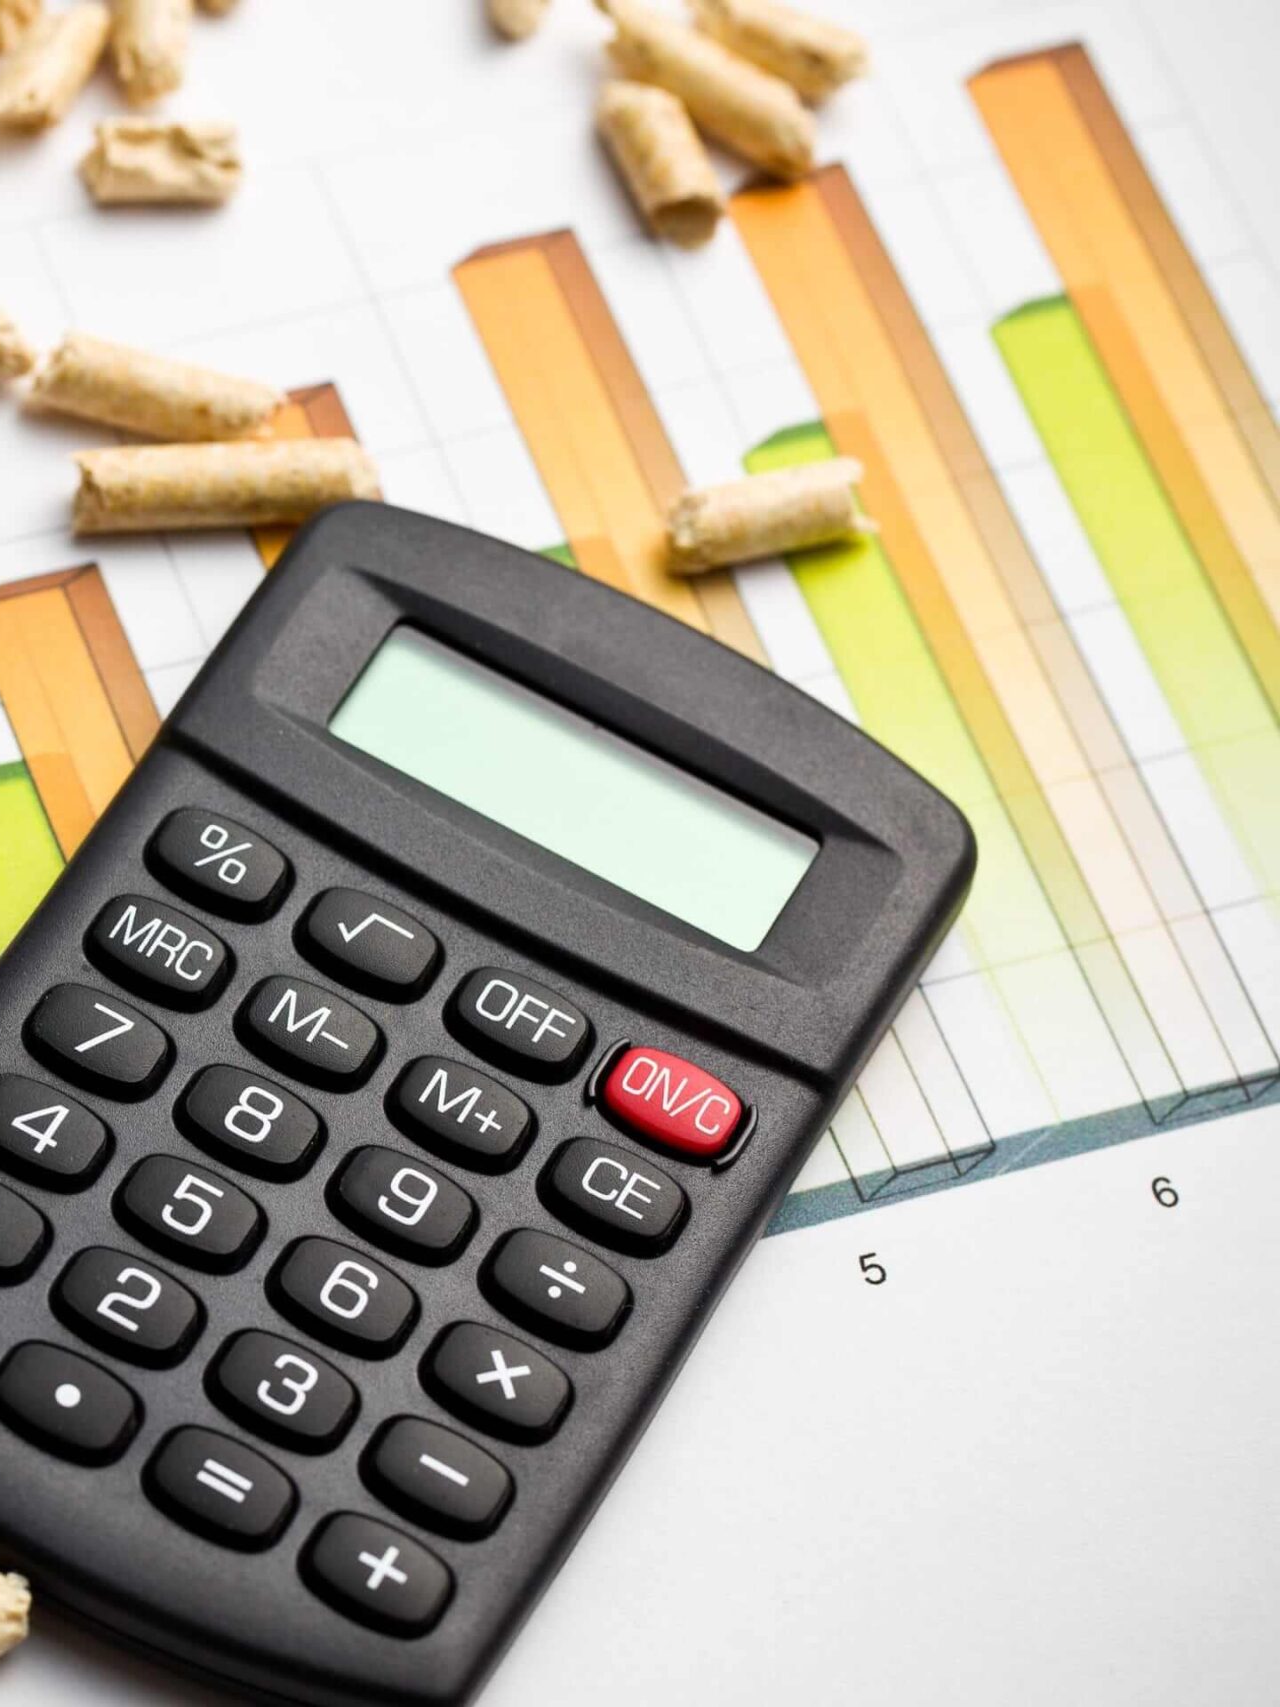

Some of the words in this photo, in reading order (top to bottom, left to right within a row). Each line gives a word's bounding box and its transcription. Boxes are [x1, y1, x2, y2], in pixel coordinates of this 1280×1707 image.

[194, 824, 253, 885] %
[109, 904, 214, 981] MRC
[74, 1002, 135, 1053] 7
[475, 979, 577, 1043] OFF
[224, 1085, 284, 1143] 8
[418, 1068, 503, 1134] M+
[621, 1056, 731, 1135] ON/C
[11, 1104, 70, 1154] 4
[161, 1173, 225, 1236] 5
[377, 1167, 439, 1226] 9
[581, 1156, 662, 1220] CE
[1151, 1177, 1179, 1208] 6
[319, 1260, 379, 1319] 6
[859, 1252, 887, 1285] 5
[96, 1267, 162, 1332] 2
[257, 1353, 319, 1415] 3
